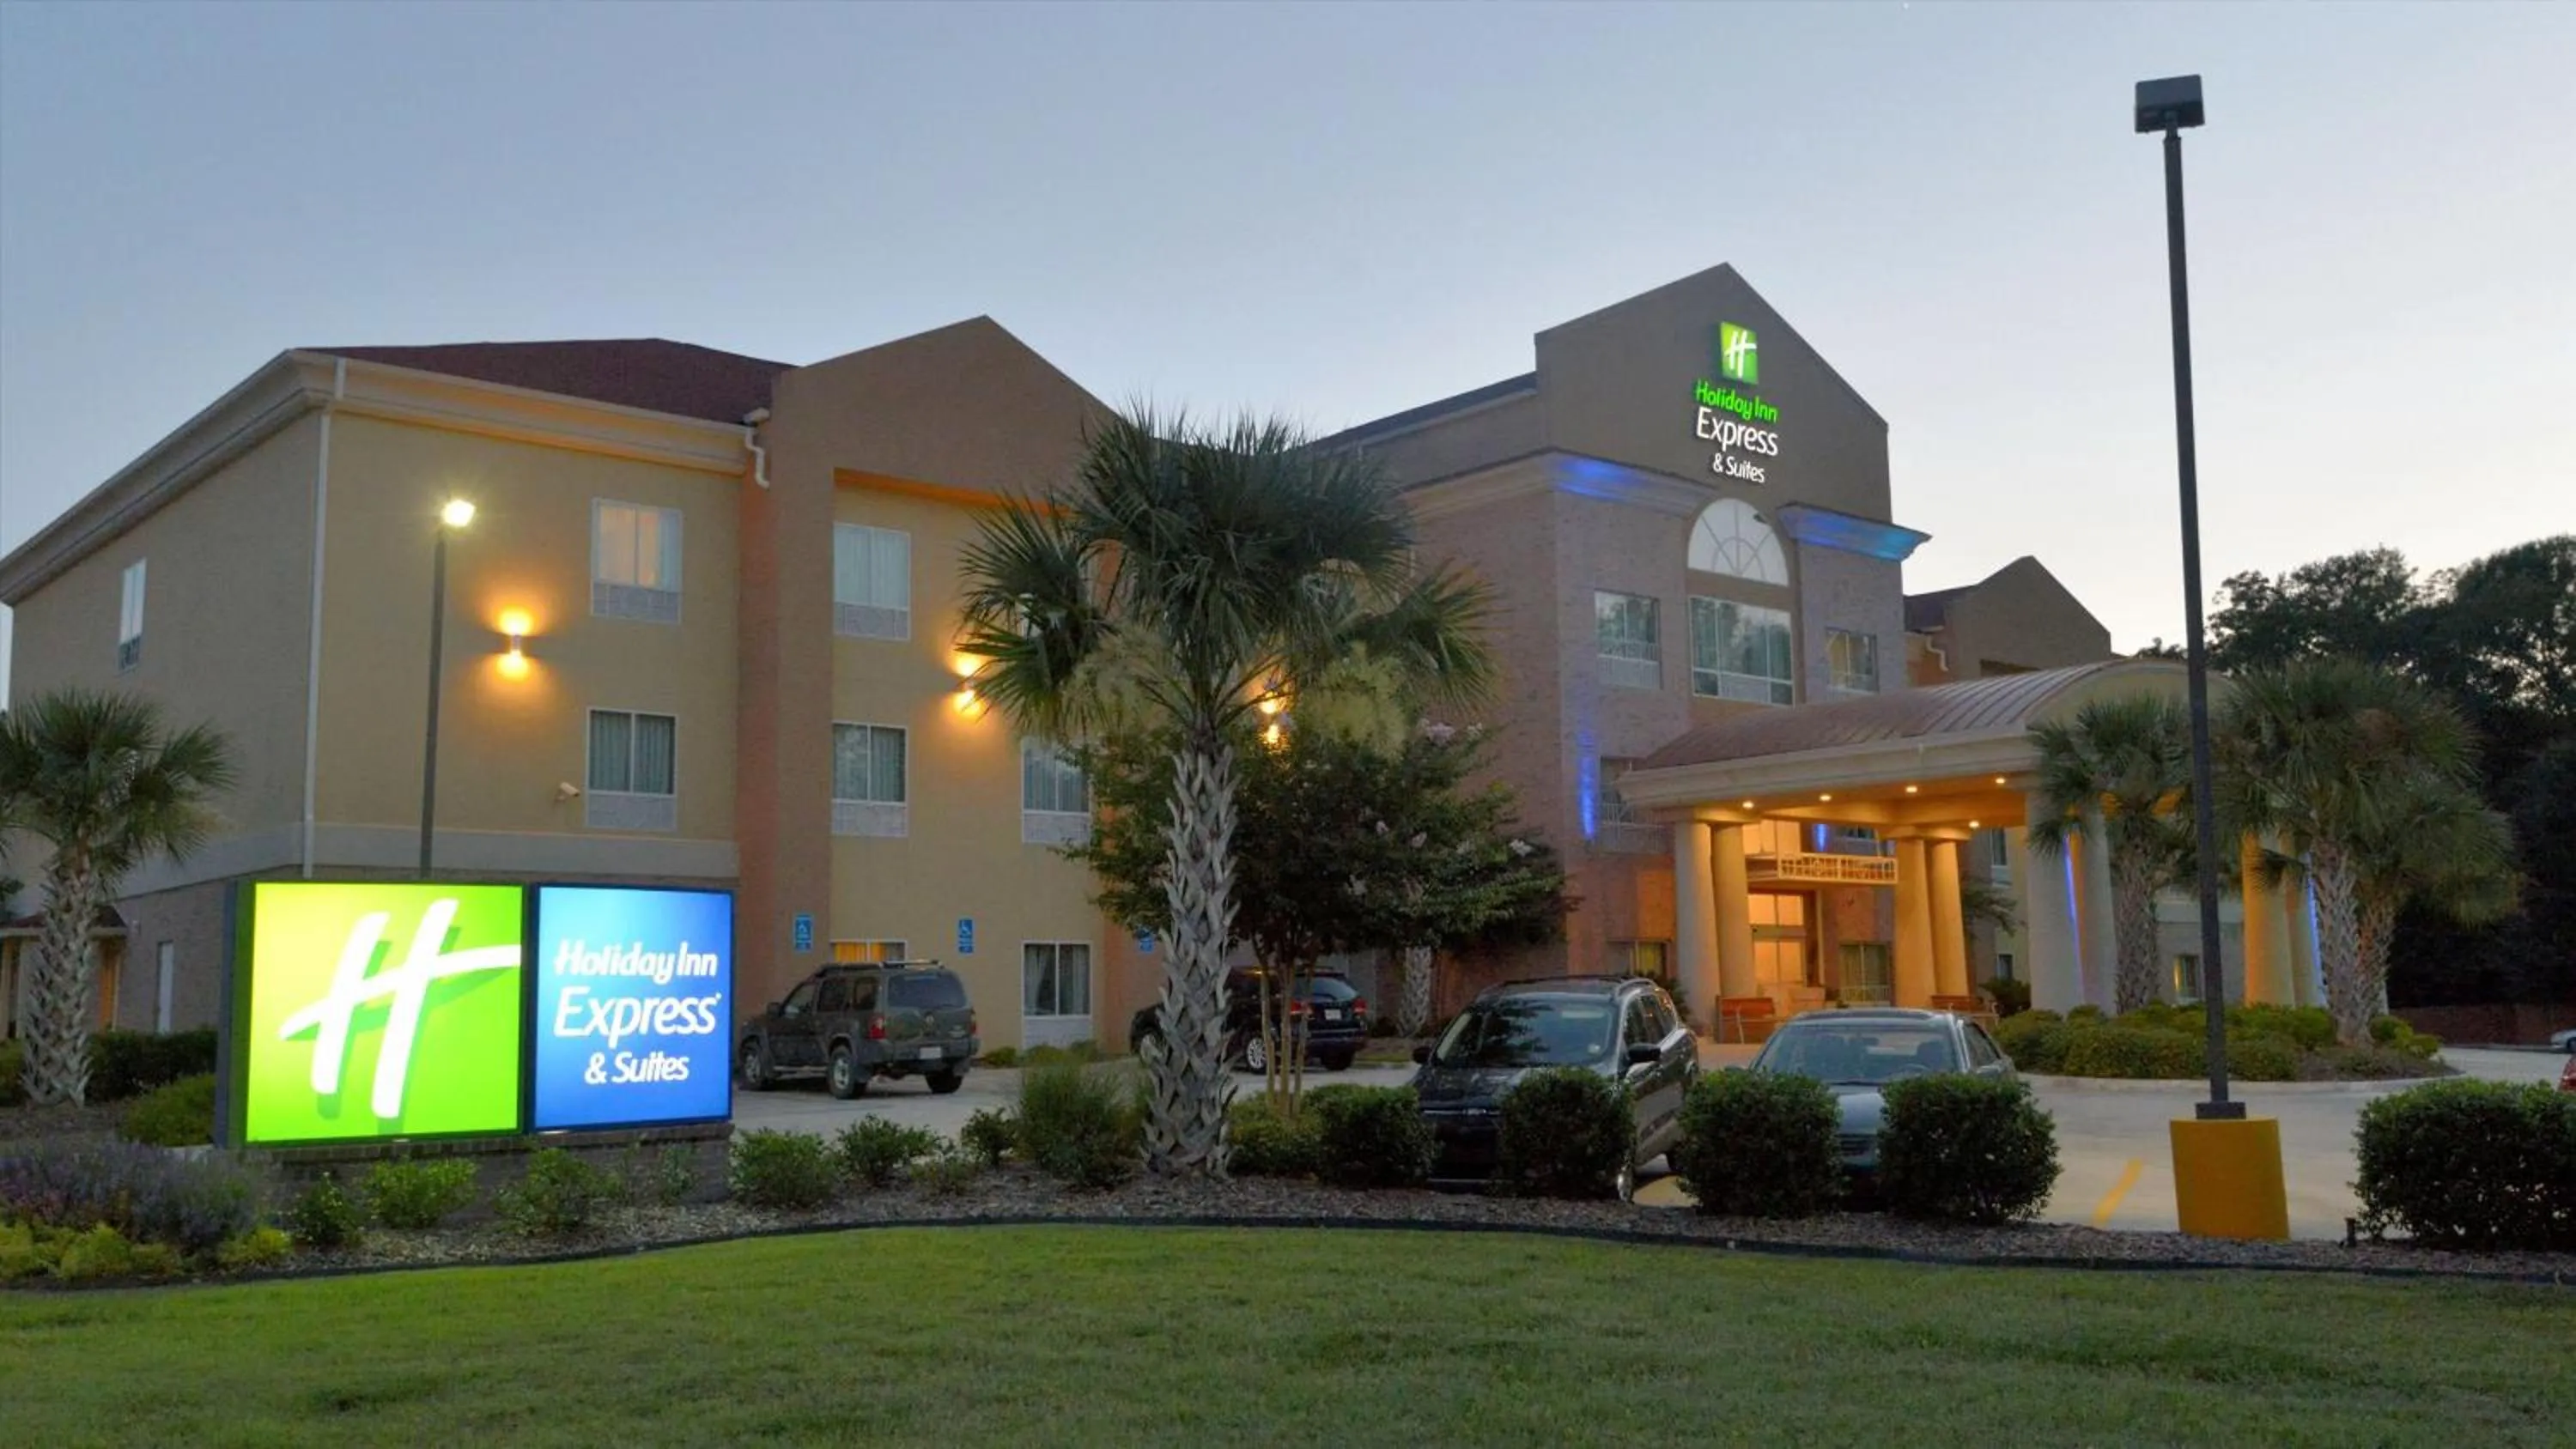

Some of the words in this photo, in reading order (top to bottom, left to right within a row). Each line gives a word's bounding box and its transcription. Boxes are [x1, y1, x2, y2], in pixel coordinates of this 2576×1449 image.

[1724, 330, 1758, 379] H
[1696, 379, 1753, 420] Holiday
[1755, 396, 1777, 422] Inn
[1696, 406, 1778, 456] Express
[1713, 453, 1722, 472] &
[1726, 456, 1765, 482] Suites
[553, 939, 675, 985] Holiday
[677, 941, 718, 976] Inn
[279, 898, 521, 1119] H
[554, 985, 717, 1049] Express
[585, 1052, 608, 1084] &
[611, 1051, 690, 1083] Suites
